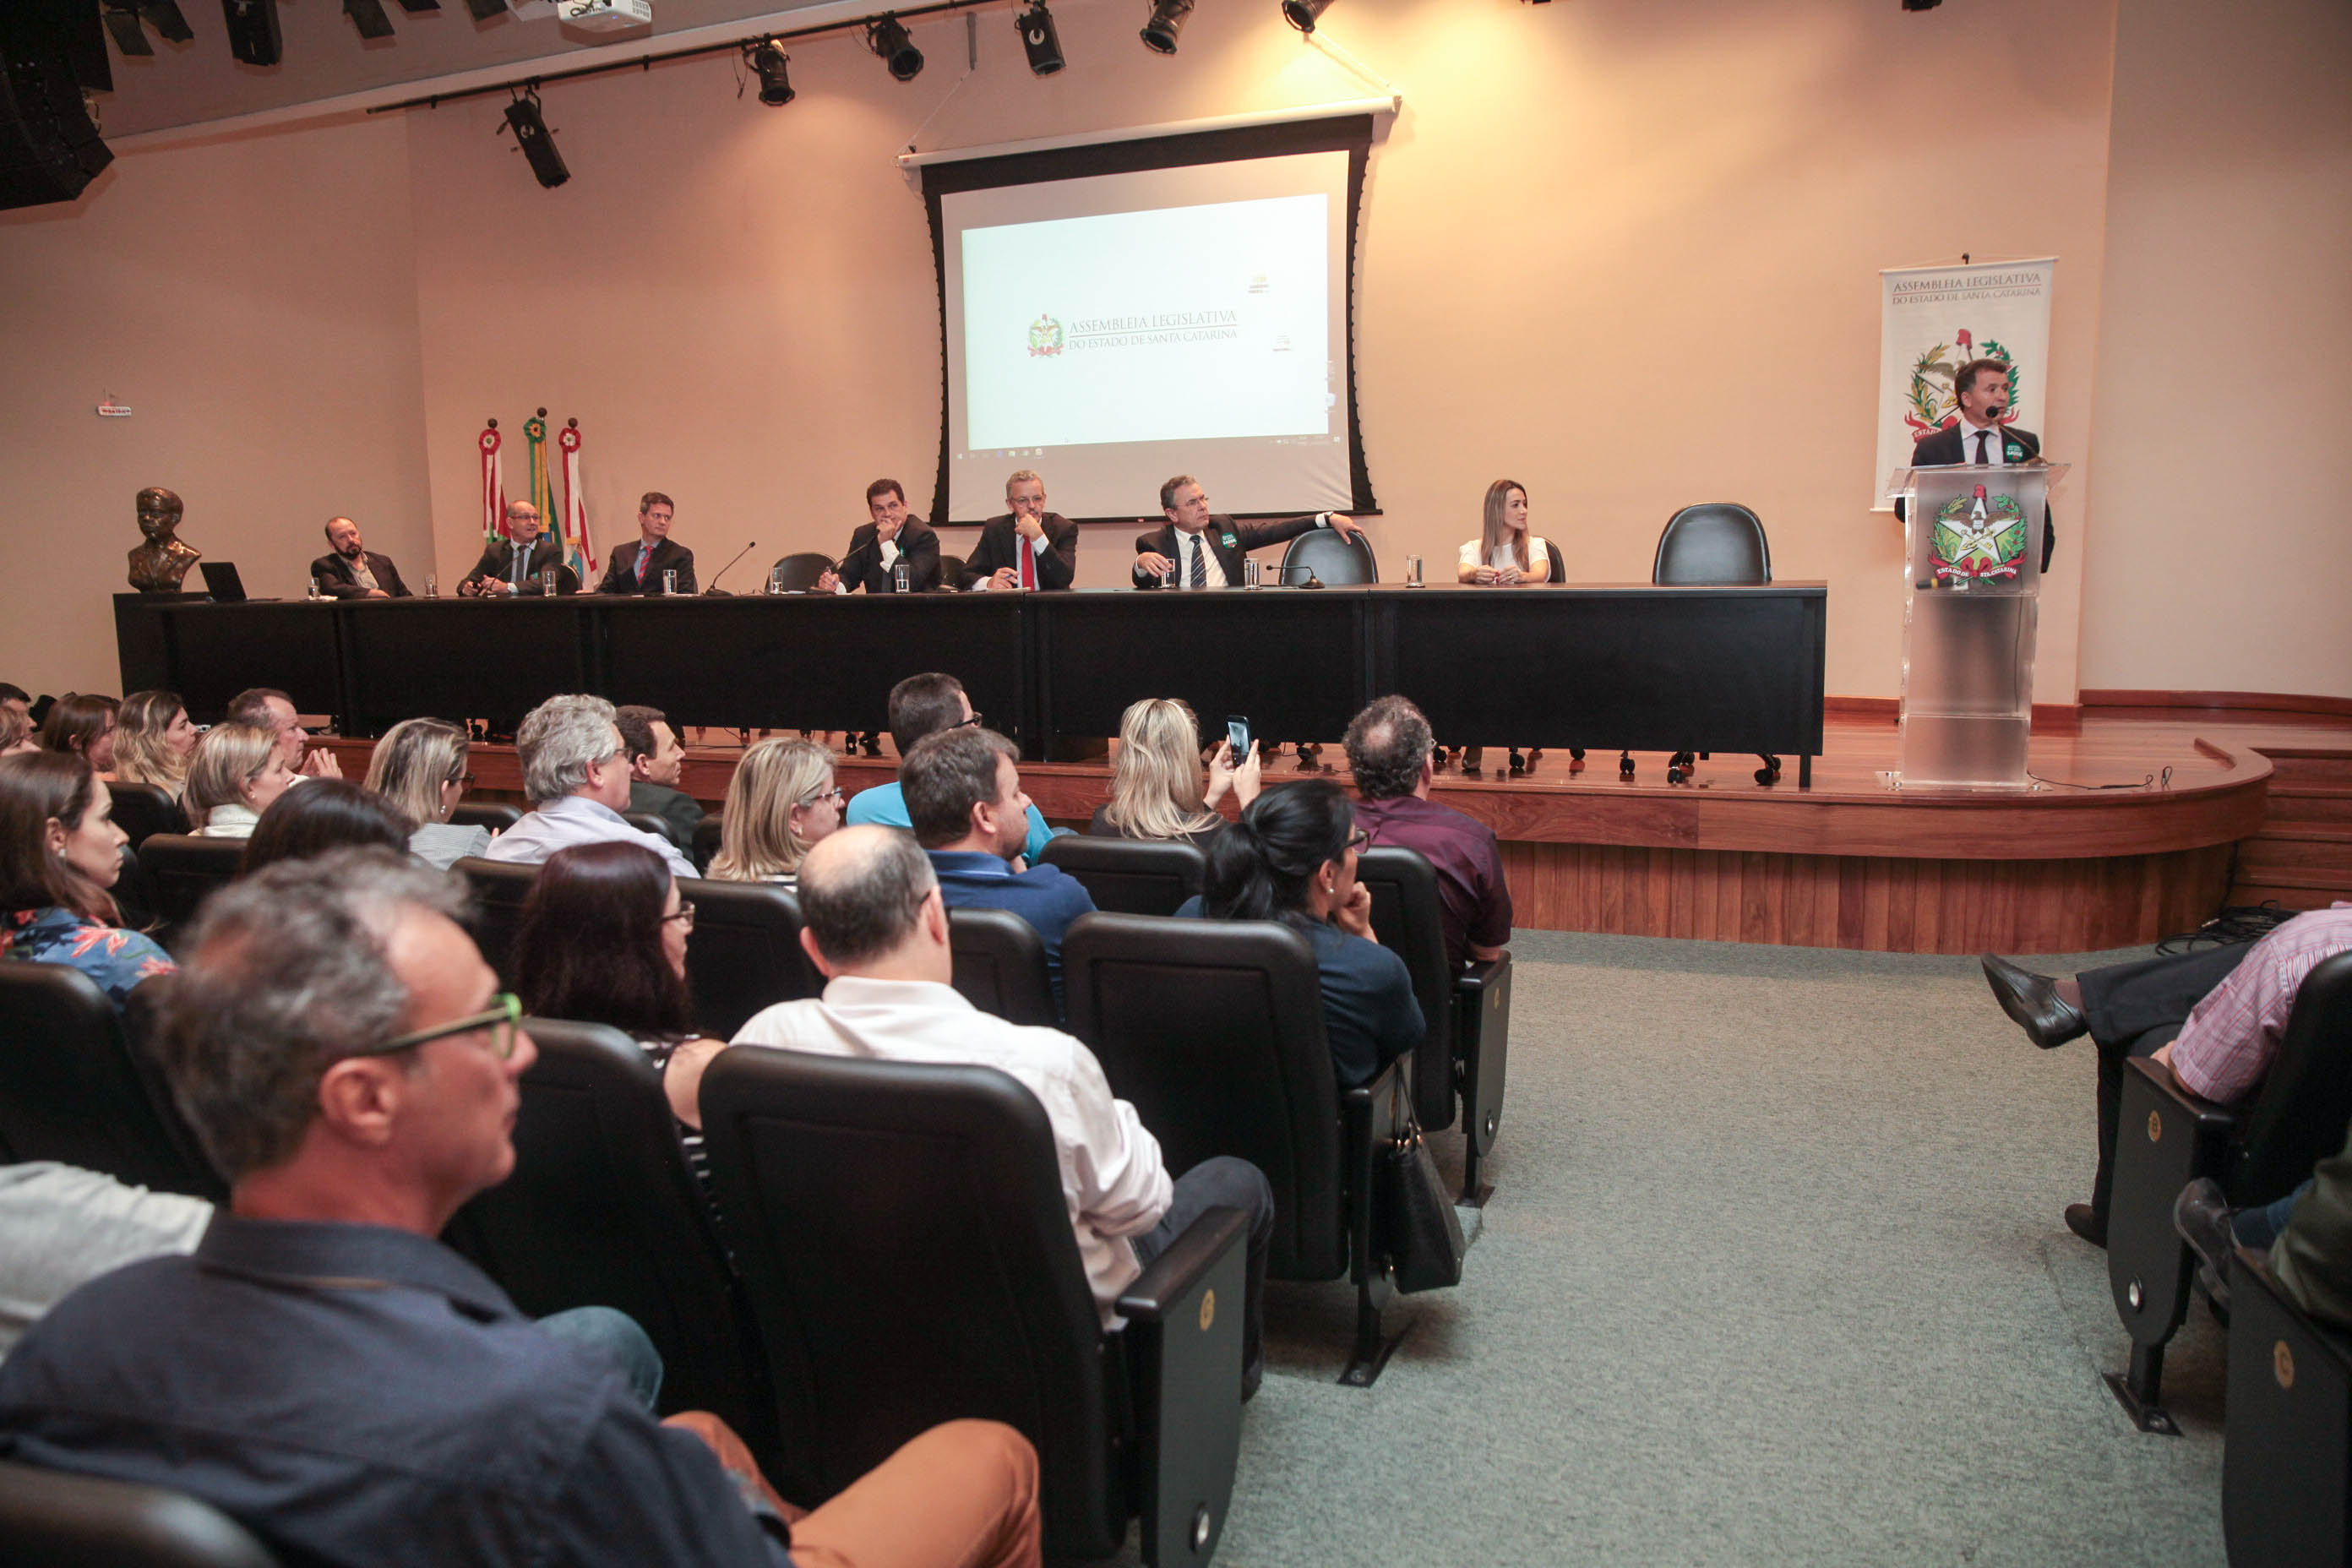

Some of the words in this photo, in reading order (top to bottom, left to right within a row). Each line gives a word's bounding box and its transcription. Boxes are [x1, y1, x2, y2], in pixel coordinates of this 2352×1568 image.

[1893, 278, 1963, 292] ASSEMBLEIA
[1967, 273, 2041, 287] LEGISLATIVA
[1892, 297, 1908, 305] DO
[1909, 295, 1943, 304] ESTADO
[1946, 293, 1958, 302] DE
[1961, 291, 1990, 301] SANTA
[1993, 288, 2041, 298] CATARINA
[1070, 317, 1148, 334] ASSEMBLEIA
[1152, 310, 1237, 328] LEGISLATIVA
[1069, 340, 1086, 350] DO
[1088, 337, 1128, 348] ESTADO
[1130, 335, 1144, 346] DE
[1148, 333, 1182, 345] SANTA
[1184, 329, 1238, 341] CATARINA
[1936, 567, 1961, 575] ESTADO
